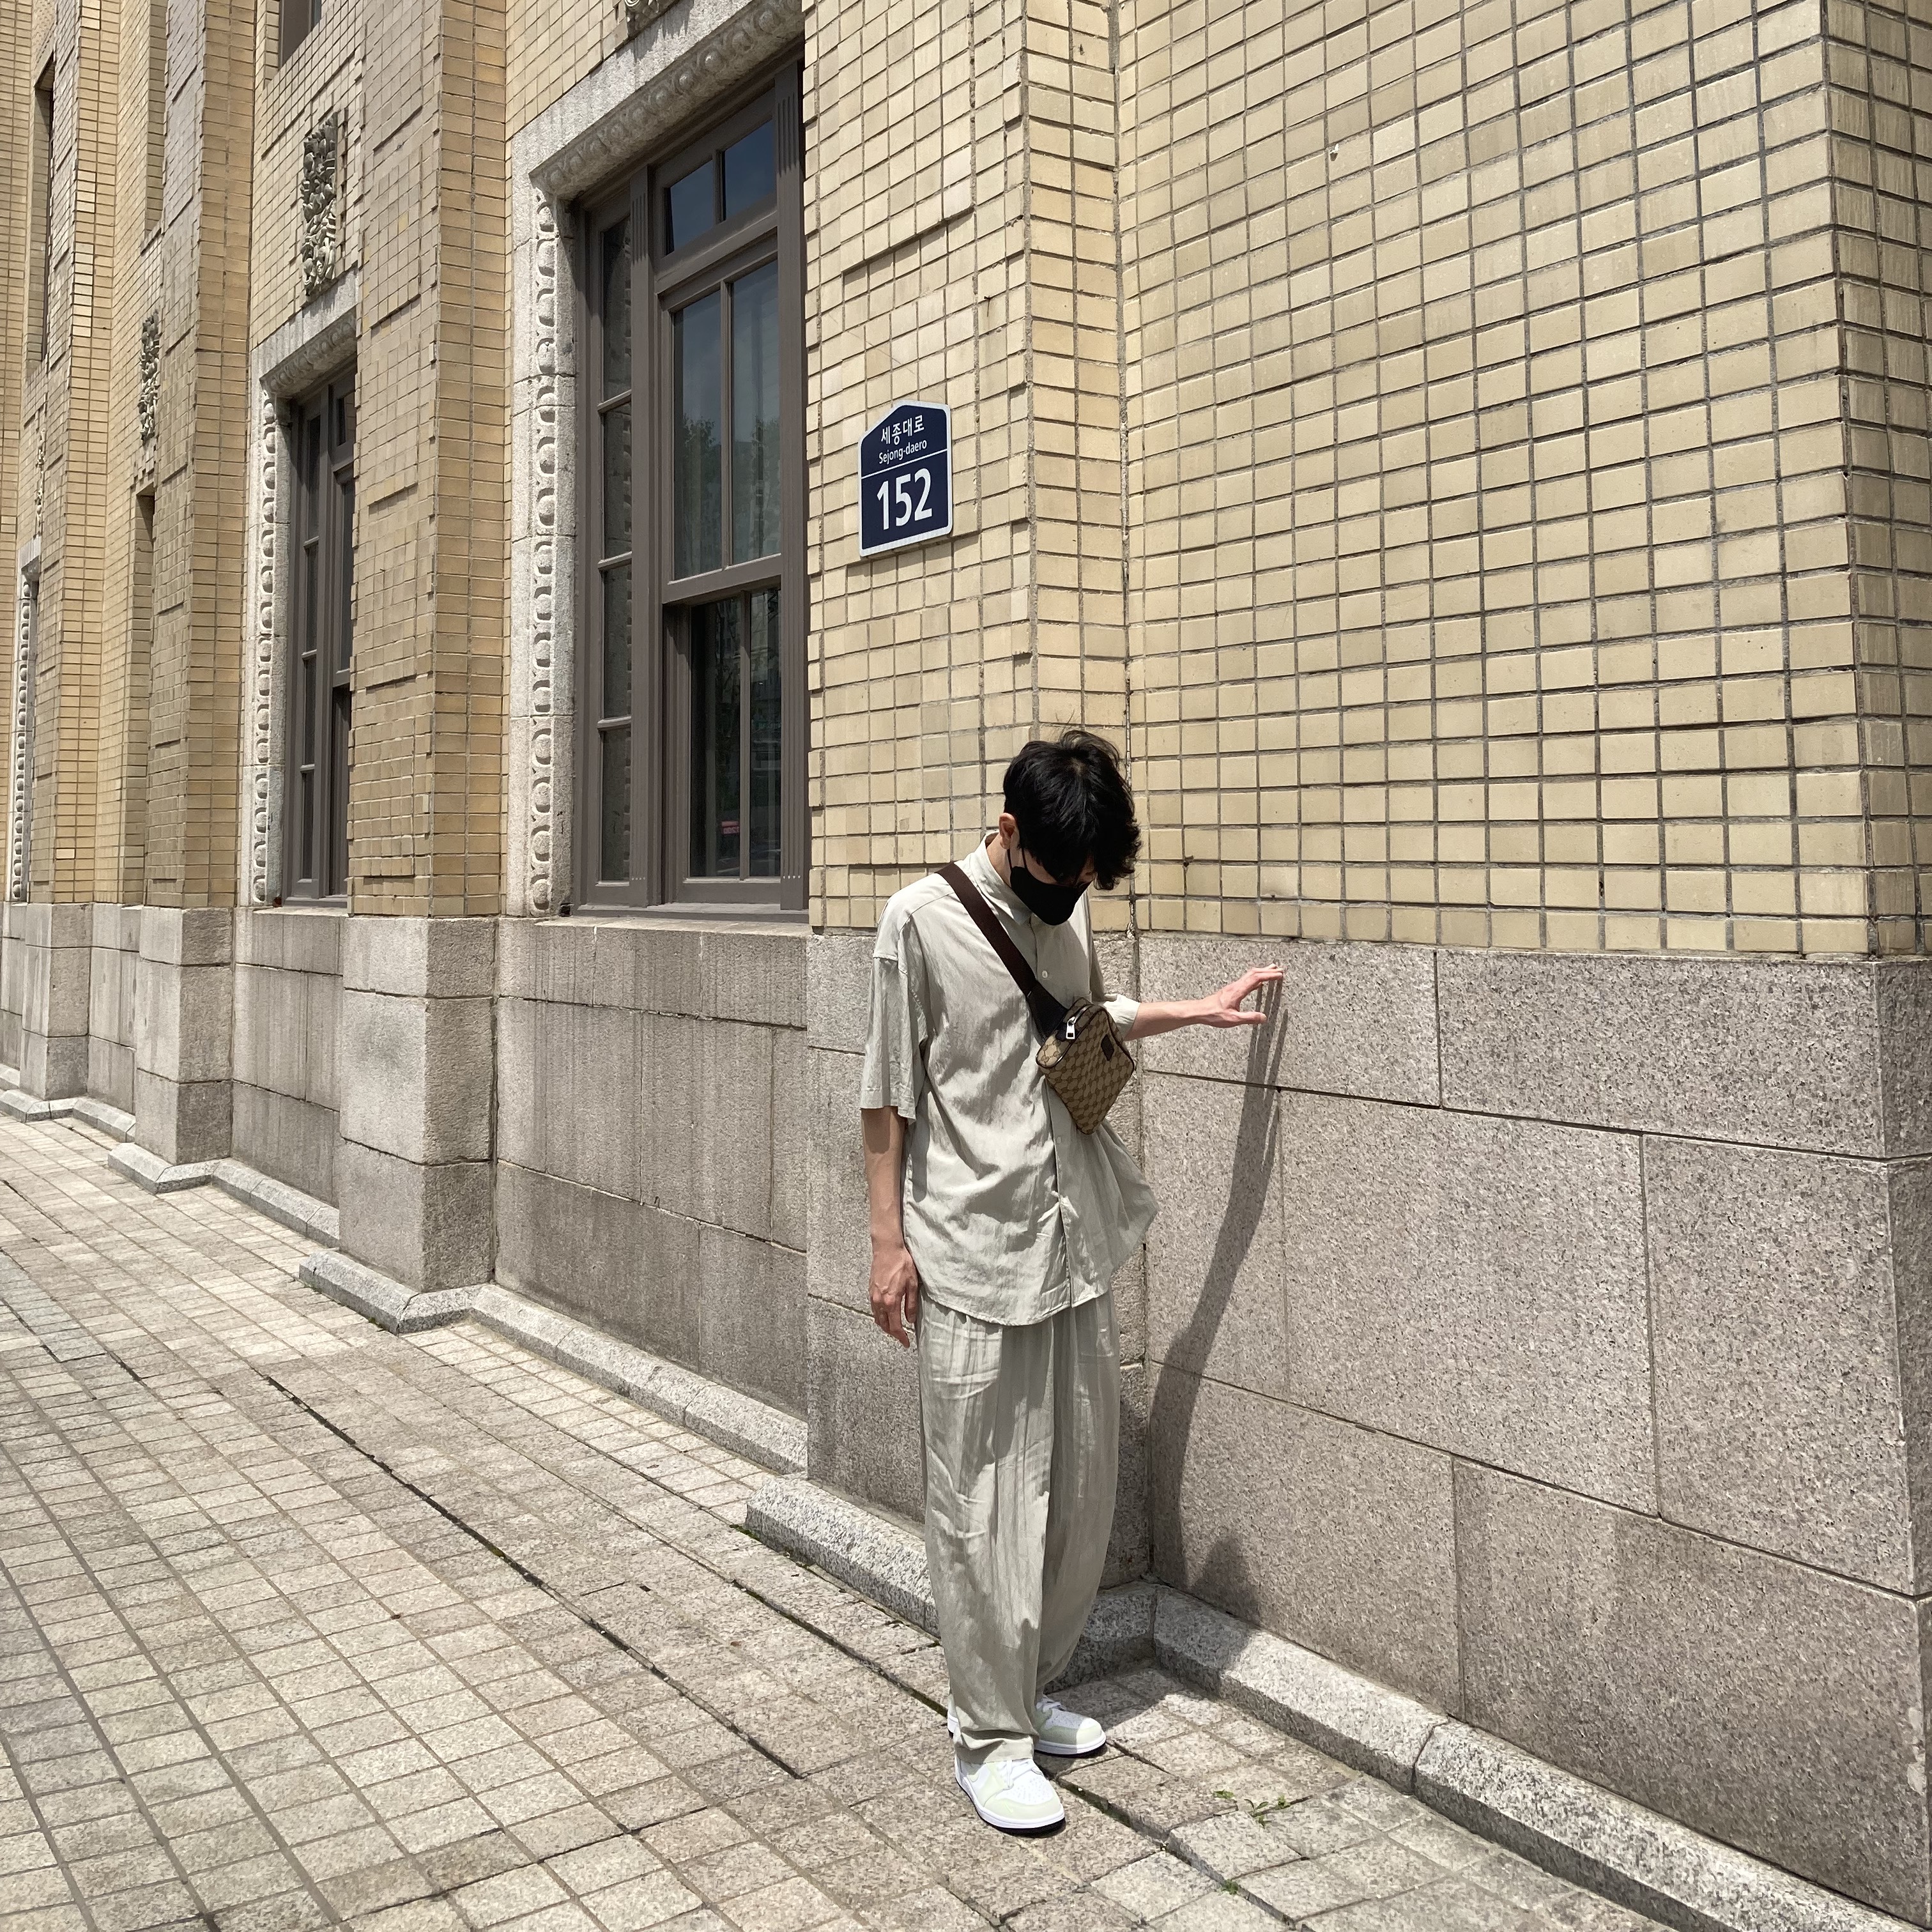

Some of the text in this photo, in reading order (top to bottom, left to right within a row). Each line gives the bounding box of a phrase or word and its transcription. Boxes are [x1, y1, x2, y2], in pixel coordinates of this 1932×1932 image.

[880, 415, 924, 445] 세종대로
[878, 439, 927, 465] Sejong-daero
[877, 468, 933, 530] 152
